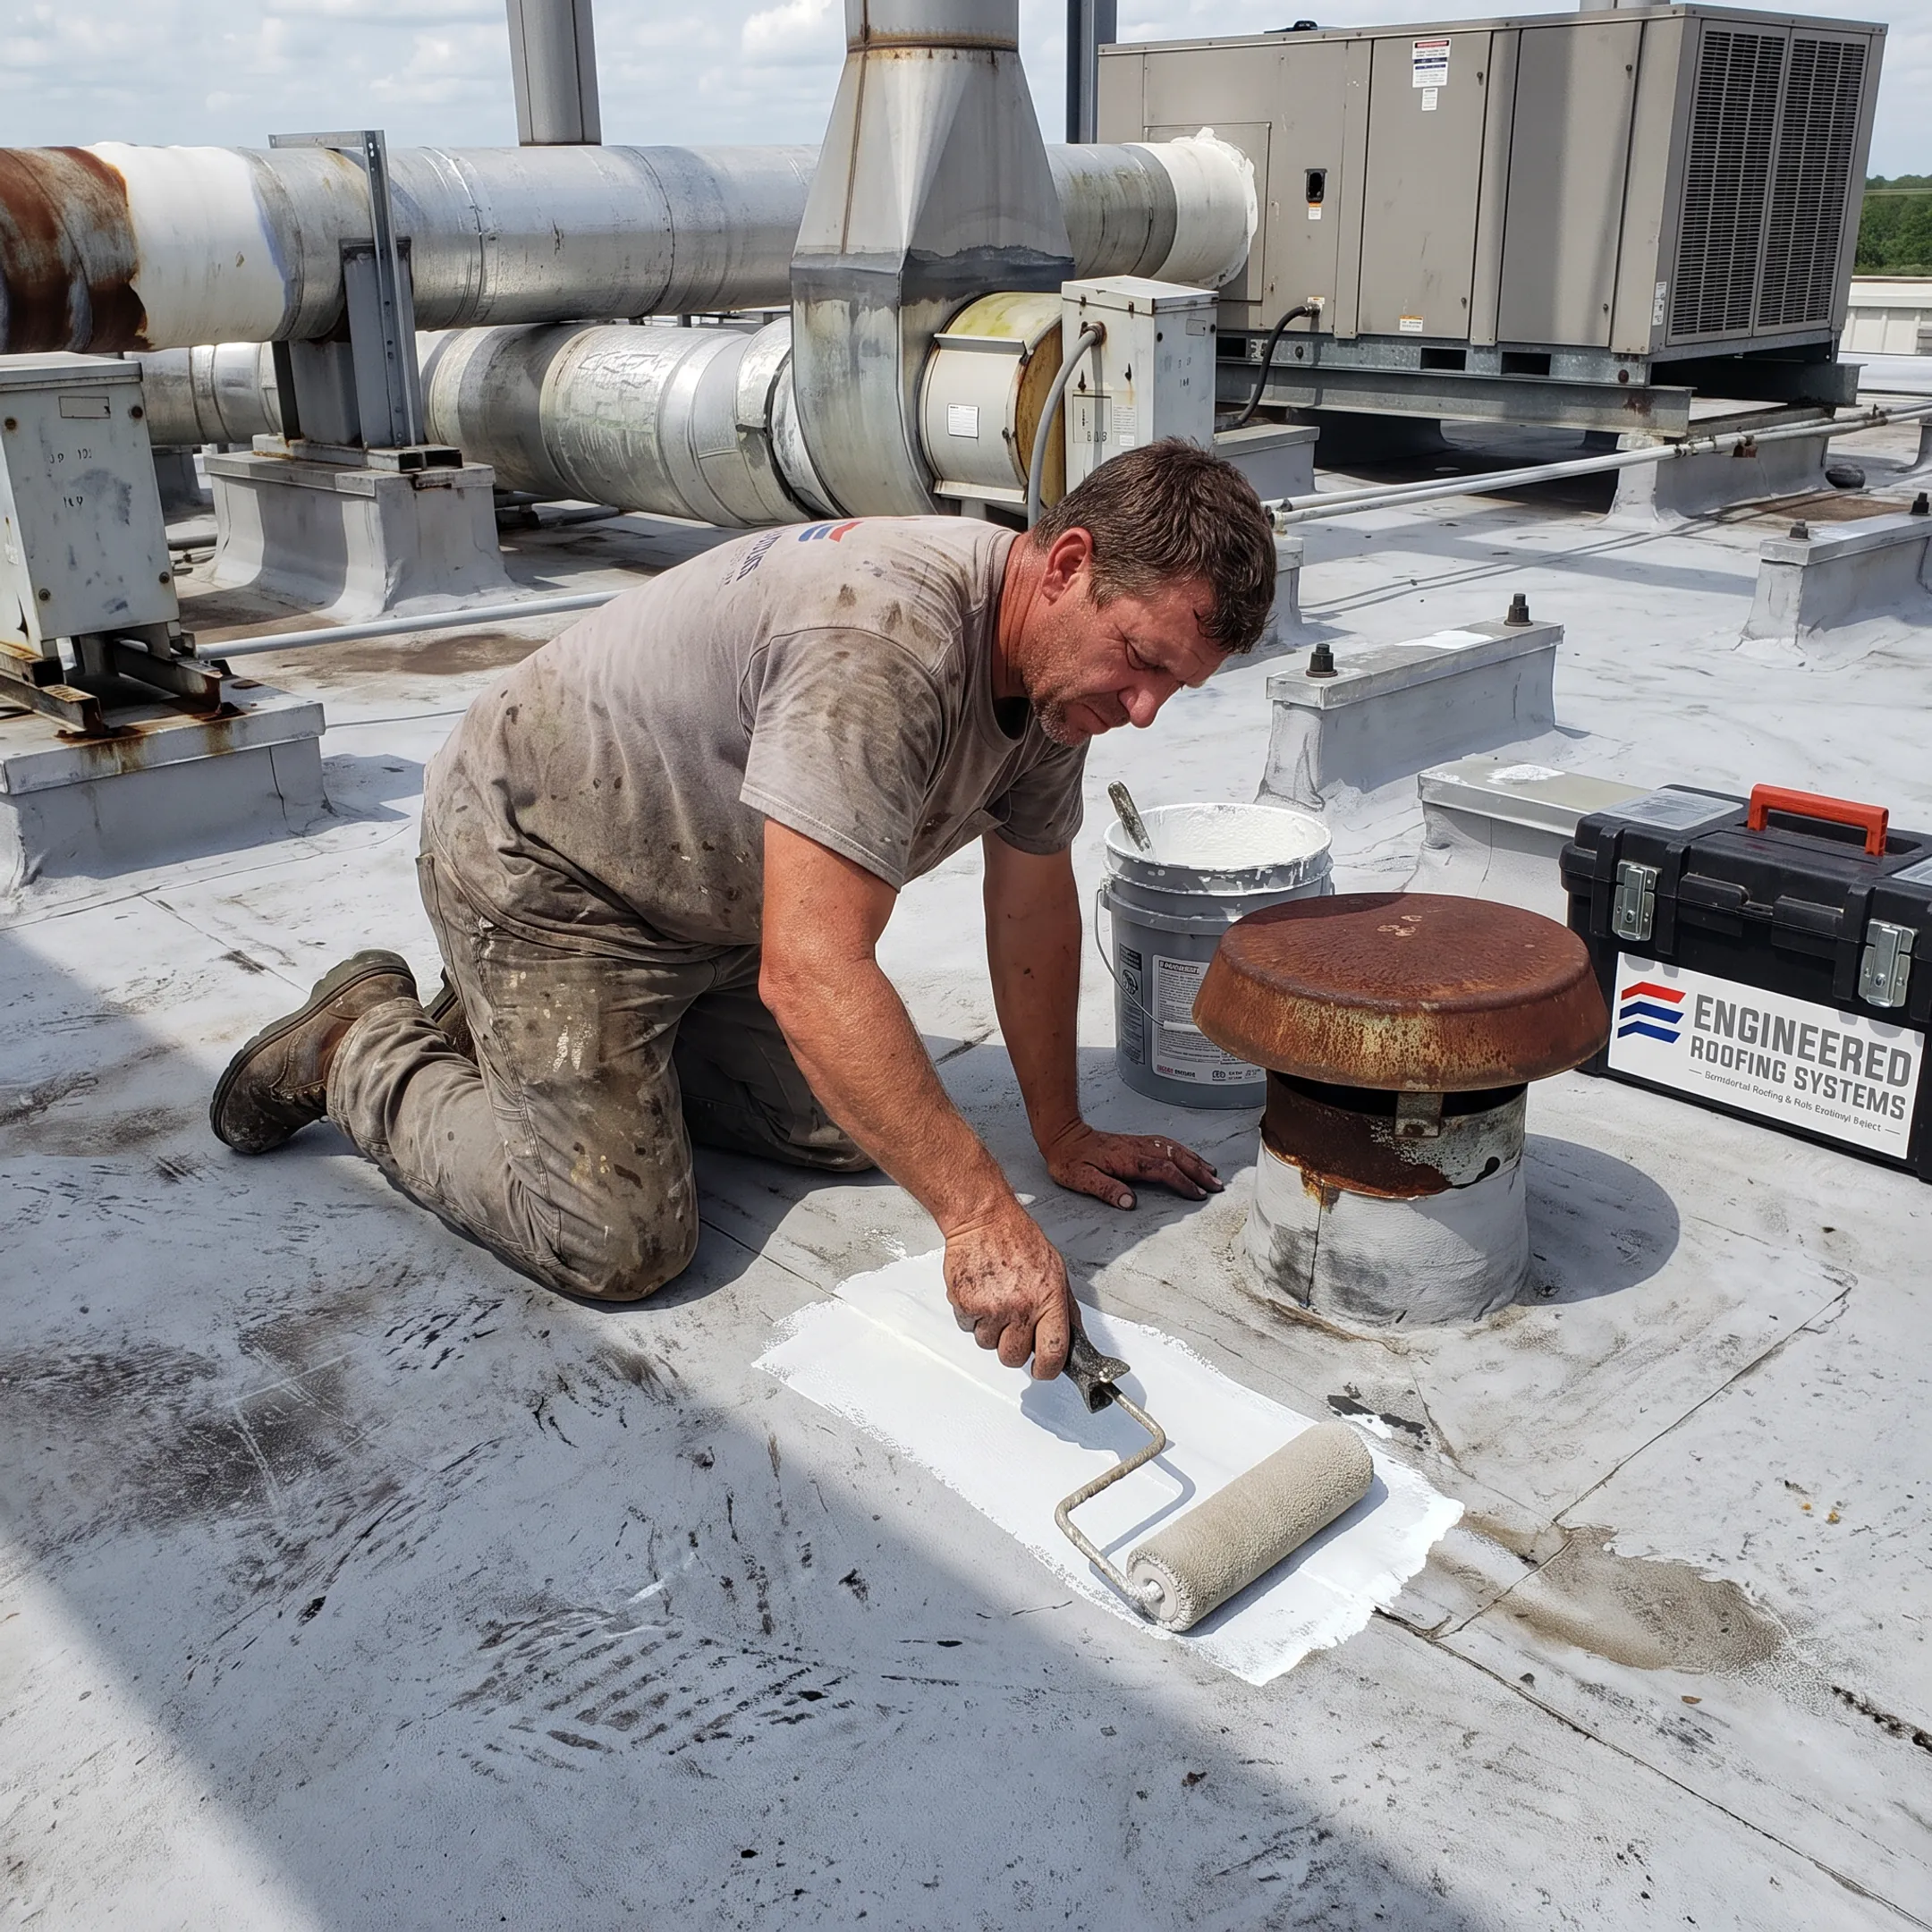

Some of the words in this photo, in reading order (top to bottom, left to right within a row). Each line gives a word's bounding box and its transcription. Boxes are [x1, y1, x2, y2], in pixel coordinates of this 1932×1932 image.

[1690, 1035, 1787, 1084] ROOFING
[1793, 1065, 1906, 1121] SYSTEMS
[1693, 994, 1912, 1088] ENGINEERED
[1784, 1095, 1792, 1105] &
